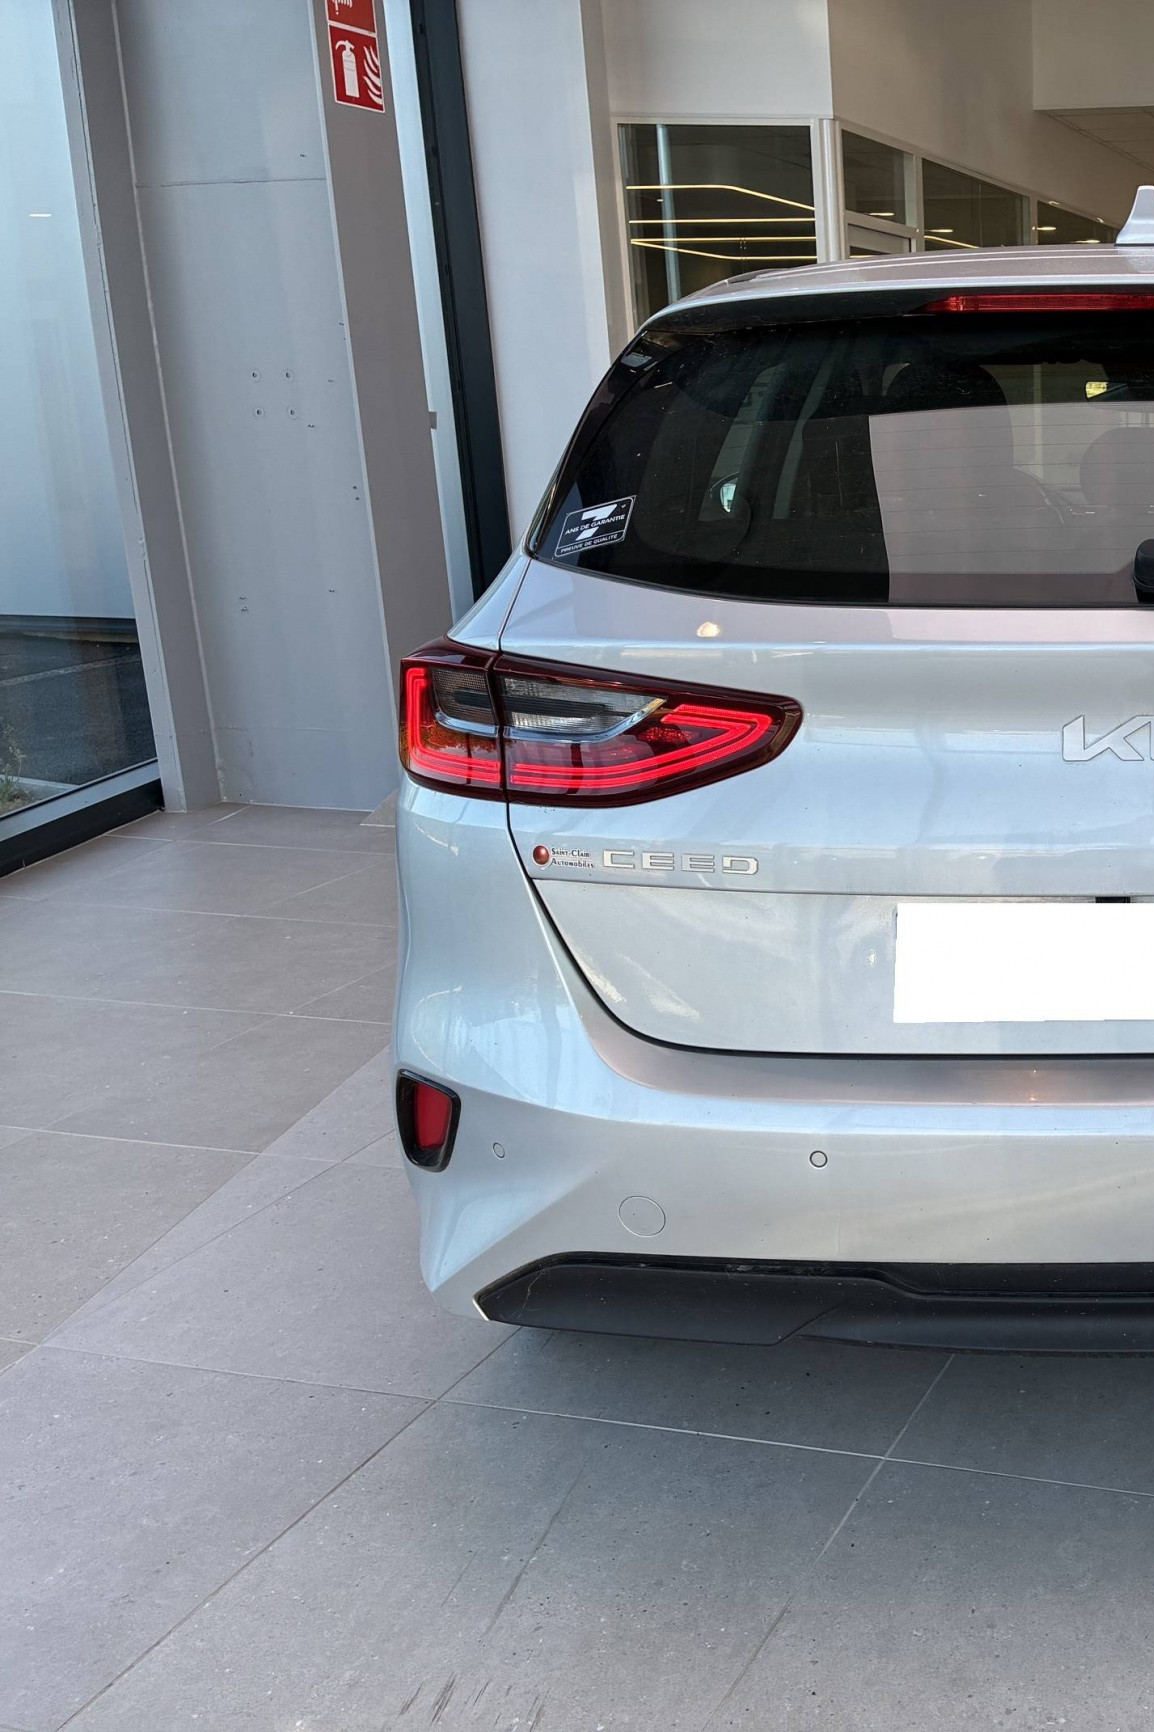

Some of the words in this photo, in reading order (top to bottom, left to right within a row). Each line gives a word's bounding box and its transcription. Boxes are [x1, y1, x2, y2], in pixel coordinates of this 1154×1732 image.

[565, 526, 580, 535] ANS
[580, 523, 591, 531] DE
[590, 514, 626, 528] GARANTIE
[560, 543, 583, 554] PREUVE
[603, 849, 759, 875] CEED
